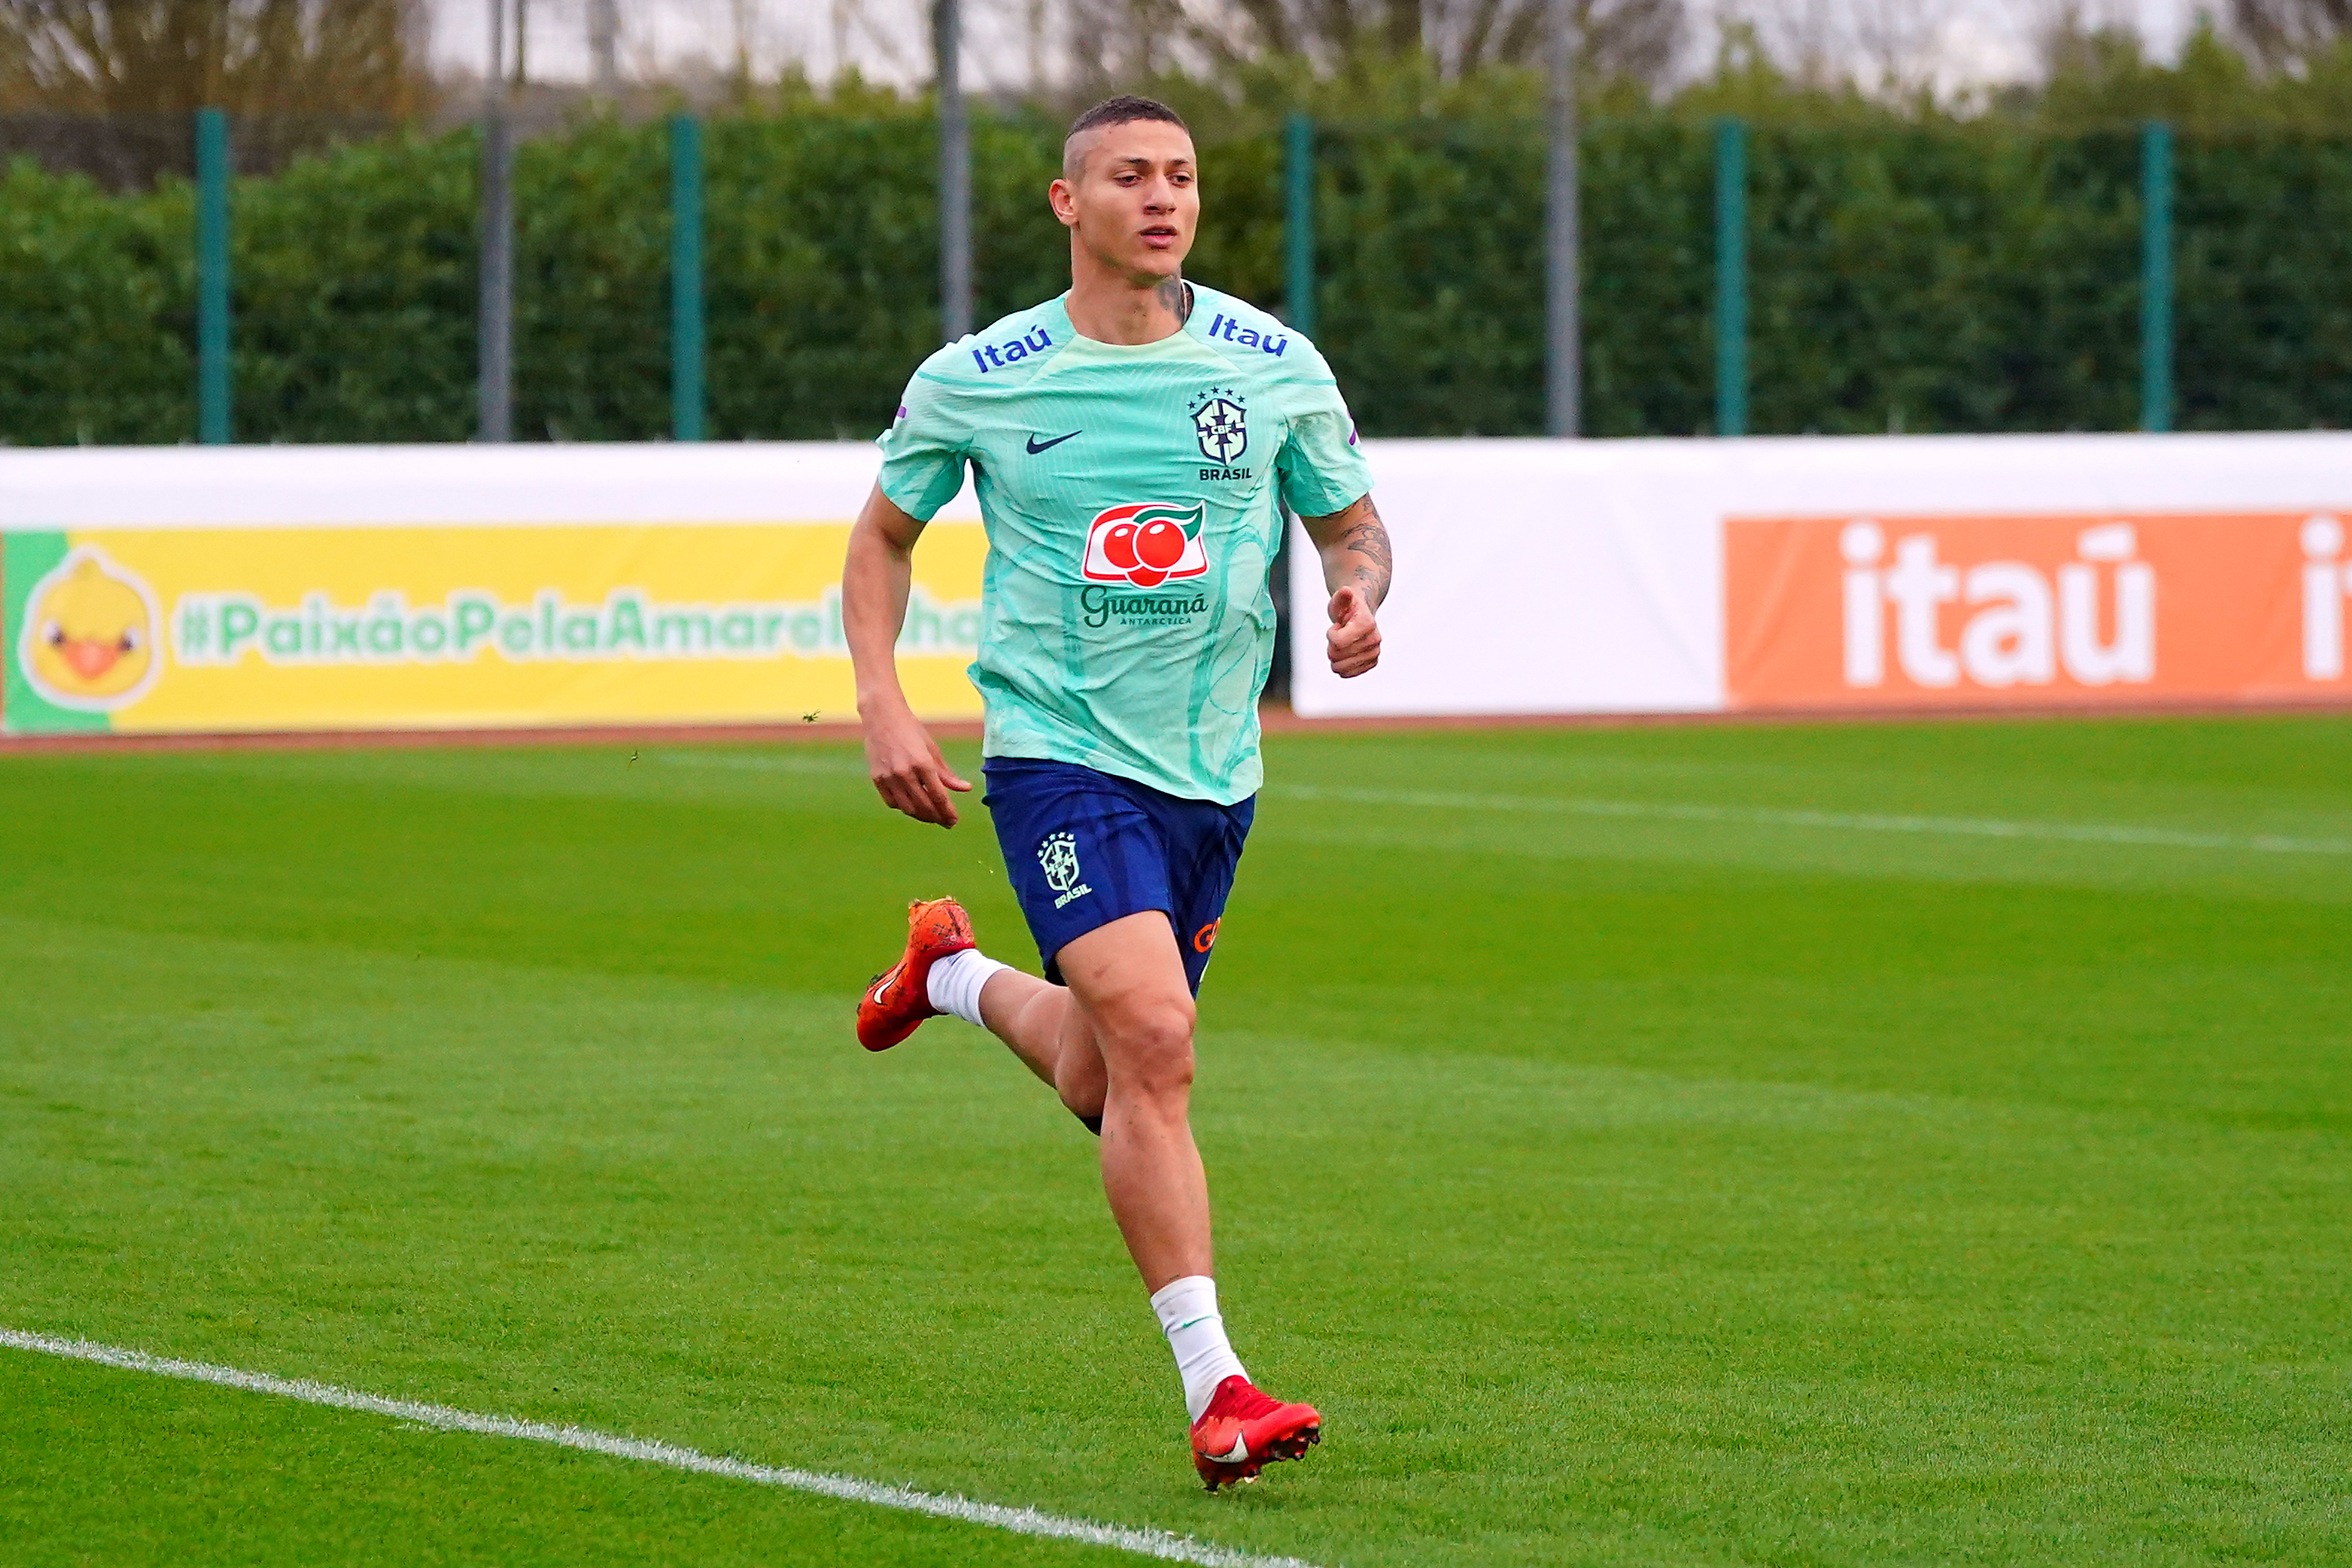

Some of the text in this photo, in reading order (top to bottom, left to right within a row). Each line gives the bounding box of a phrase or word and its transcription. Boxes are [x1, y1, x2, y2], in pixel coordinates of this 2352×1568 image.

[972, 324, 1052, 373] Itaú
[1207, 313, 1288, 358] Itaú
[1210, 424, 1232, 434] CBF
[1199, 468, 1252, 481] BRASIL
[177, 592, 982, 657] #PaixãoPelaAmarelha
[1081, 584, 1209, 628] Guaraná
[1120, 617, 1192, 625] ANTARCTICA
[1839, 519, 2156, 689] itaú
[1054, 883, 1093, 909] BRASIL
